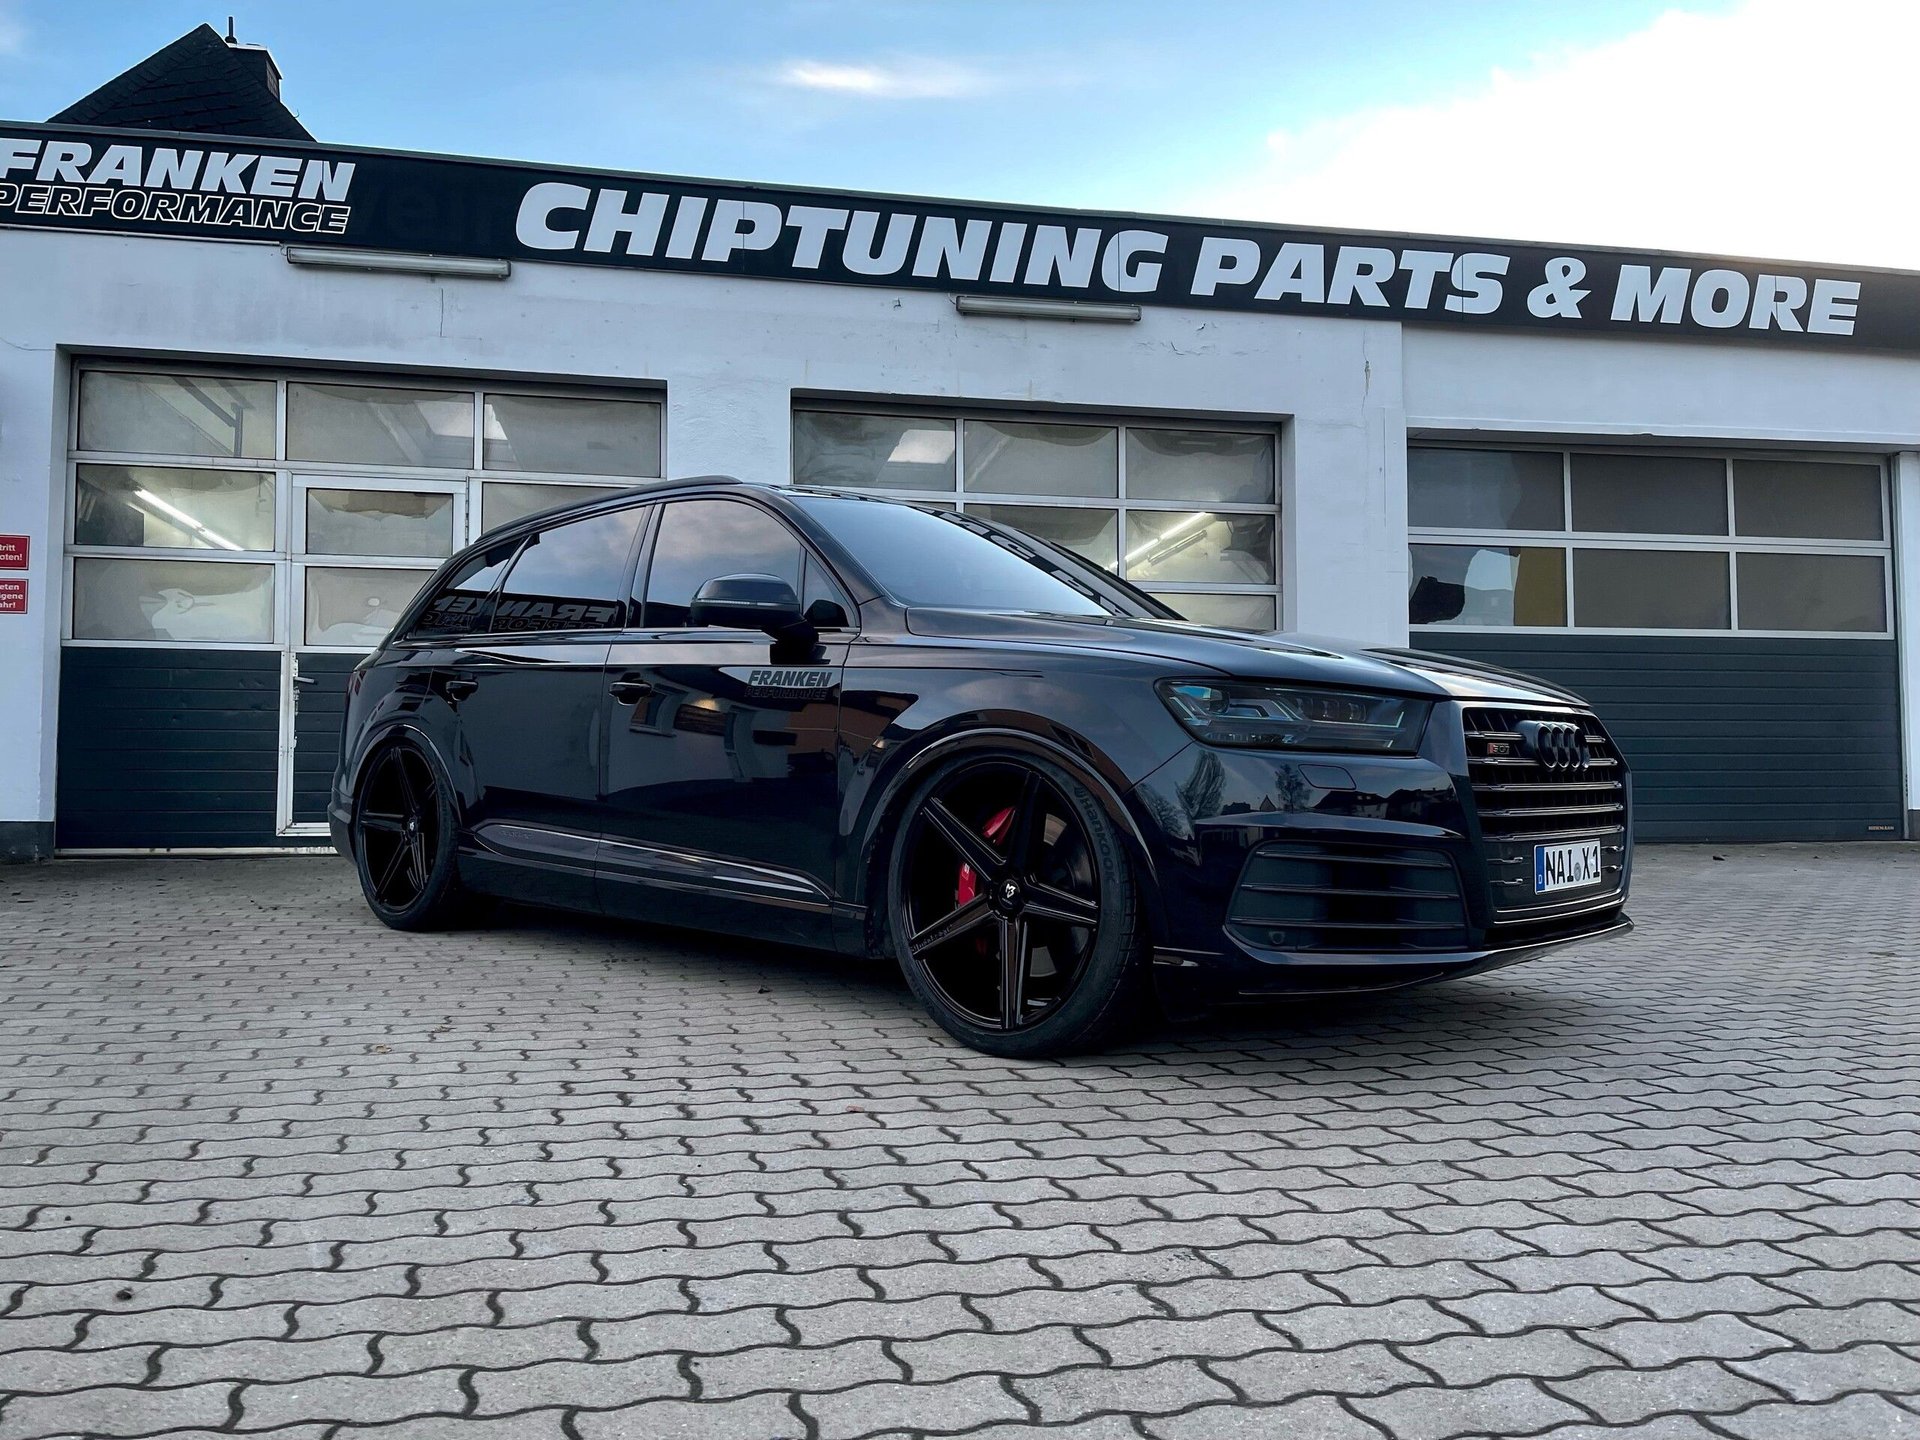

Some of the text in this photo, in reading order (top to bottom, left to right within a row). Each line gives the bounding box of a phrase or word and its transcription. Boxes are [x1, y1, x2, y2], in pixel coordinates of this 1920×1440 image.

[0, 137, 356, 201] FRANKEN
[515, 182, 1862, 336] CHIPTUNING PARTS & MORE
[748, 670, 832, 687] FRANKEN
[1545, 849, 1574, 886] NAI
